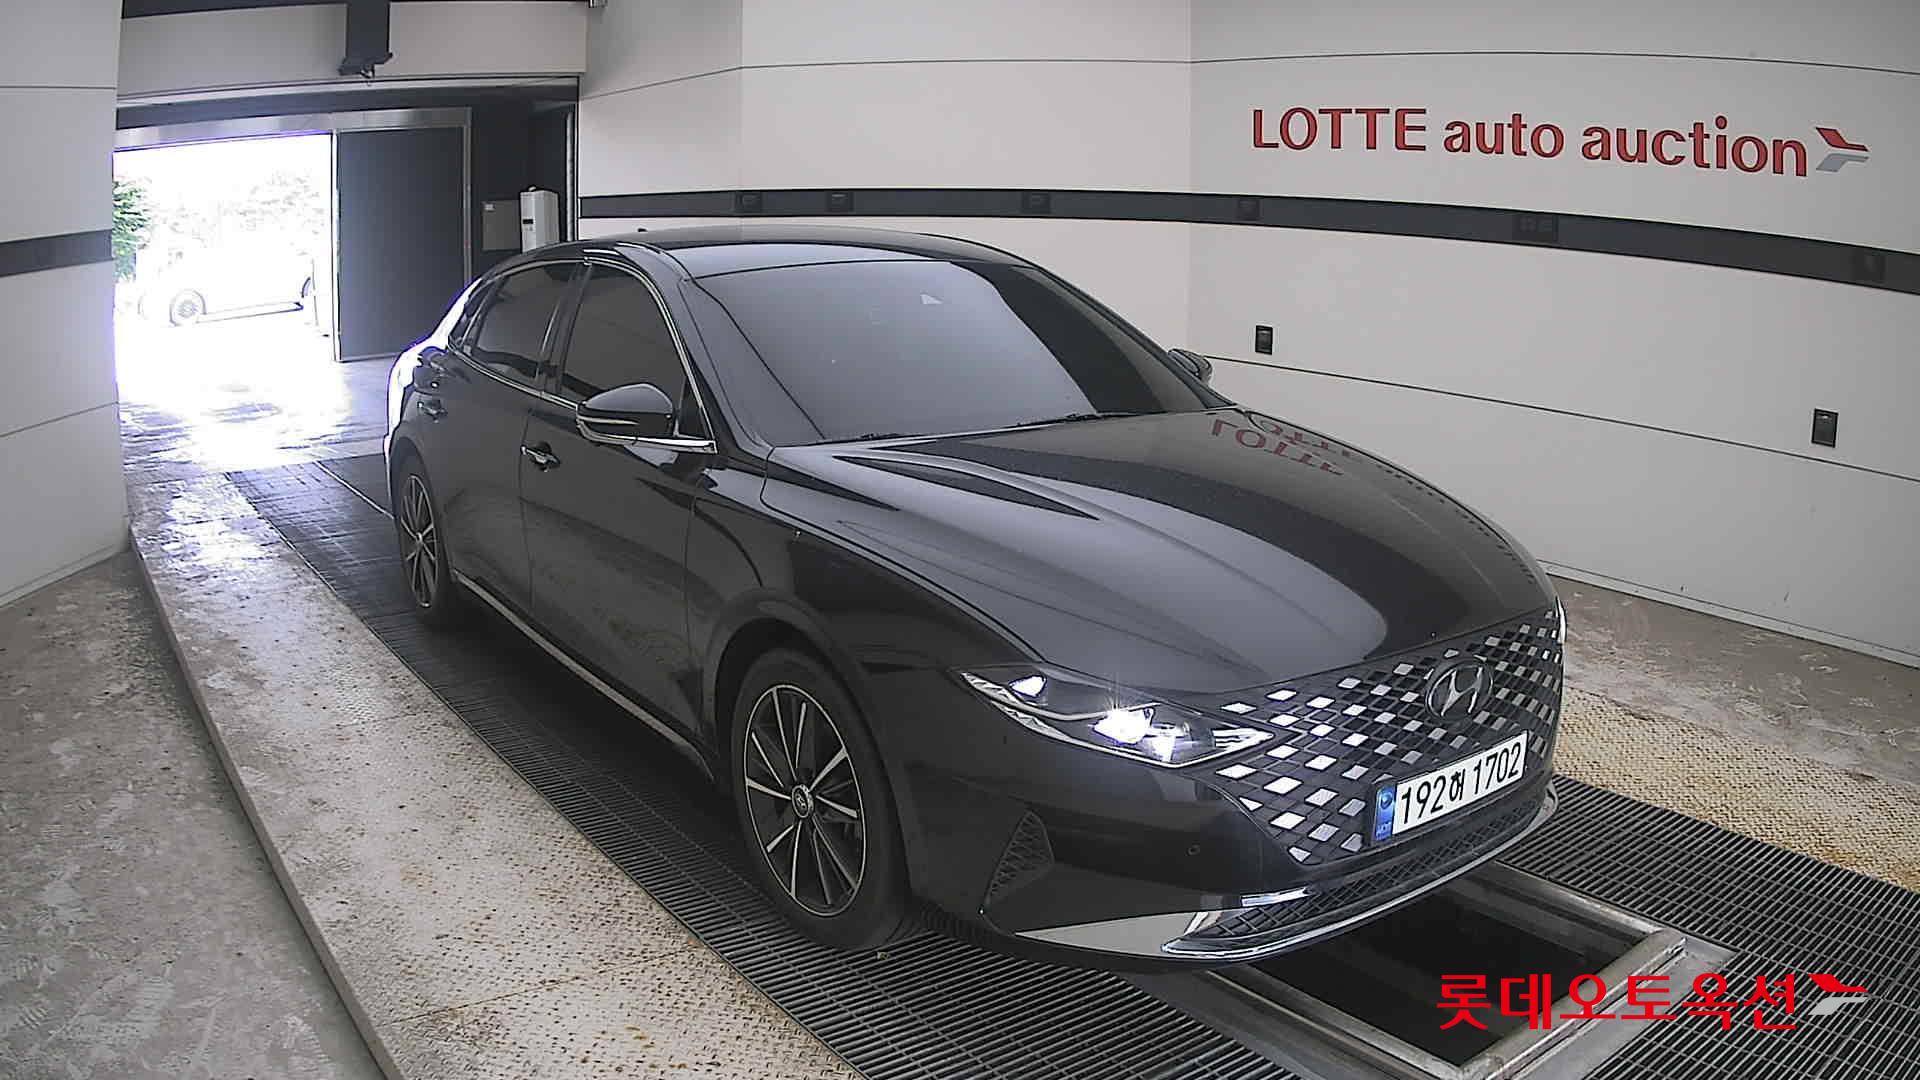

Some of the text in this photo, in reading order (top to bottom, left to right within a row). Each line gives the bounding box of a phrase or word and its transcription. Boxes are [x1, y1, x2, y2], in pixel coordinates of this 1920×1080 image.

[1252, 107, 1808, 177] LOTTE auto auction
[1401, 741, 1521, 825] 192허 1702
